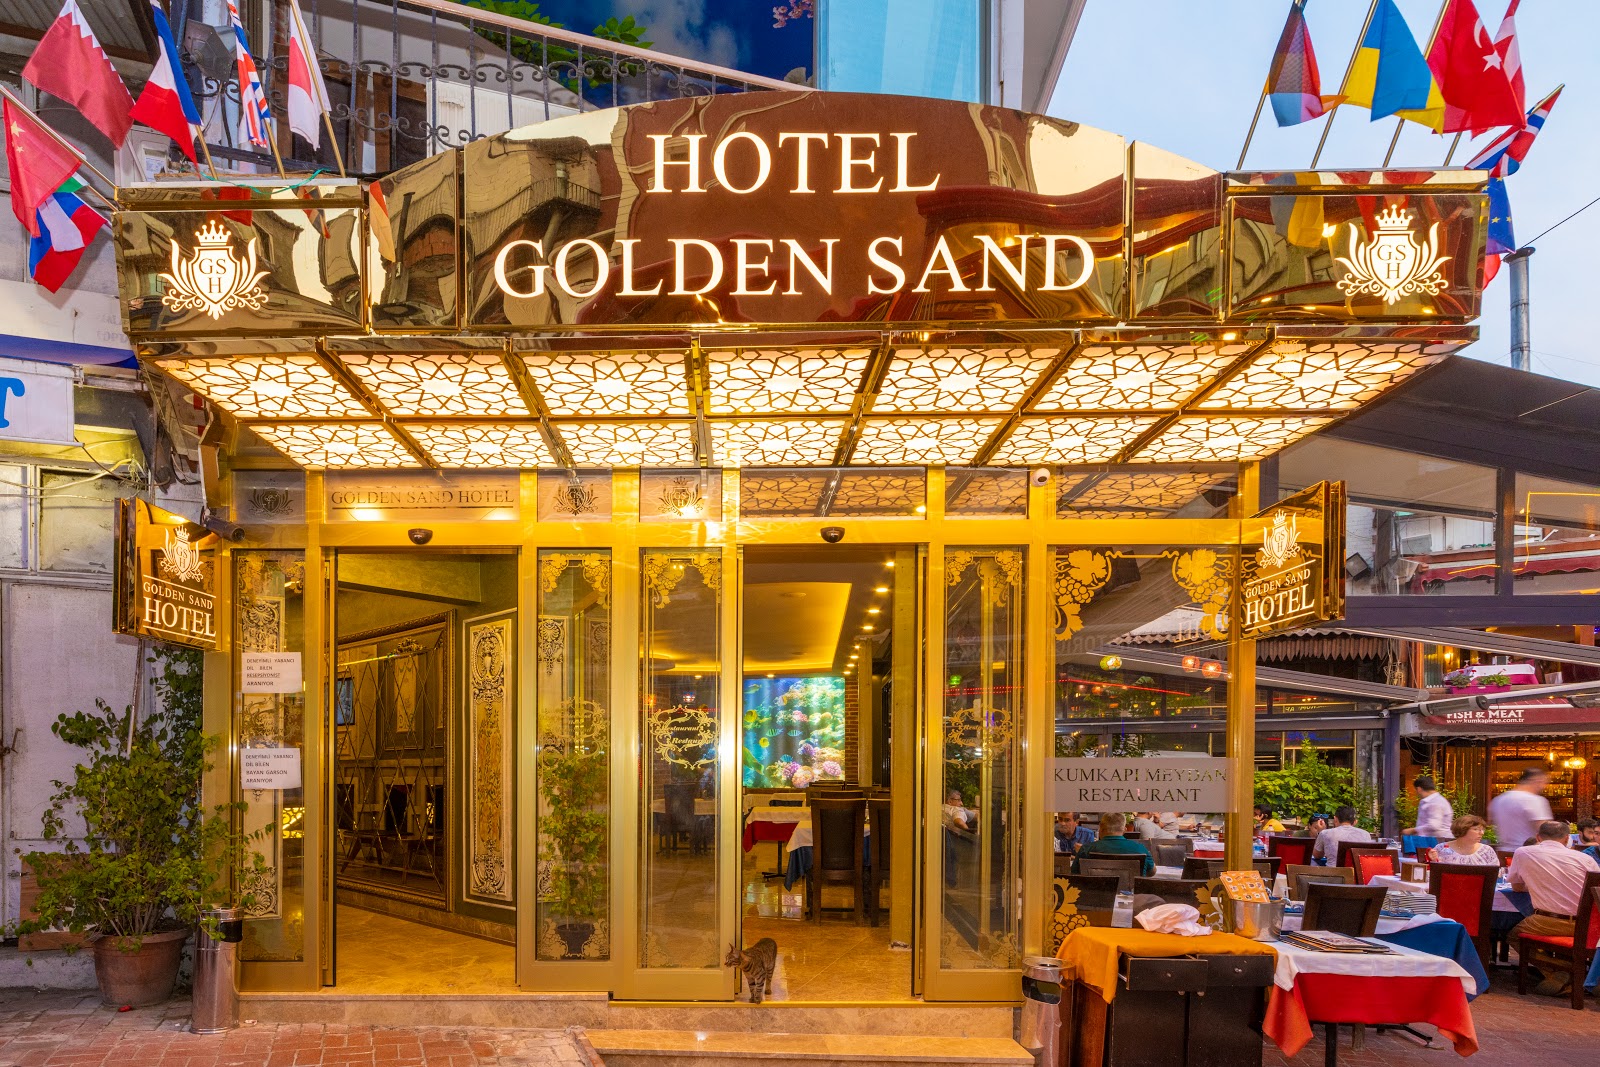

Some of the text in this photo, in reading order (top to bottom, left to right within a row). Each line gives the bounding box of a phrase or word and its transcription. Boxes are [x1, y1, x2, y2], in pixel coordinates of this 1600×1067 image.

[646, 132, 941, 194] HOTEL
[1377, 244, 1407, 261] GS
[198, 258, 227, 275] GS
[493, 234, 1095, 299] GOLDEN SAND
[1386, 262, 1401, 279] H
[208, 277, 222, 294] H
[331, 490, 515, 504] GOLDEN SAND HOTEL
[1245, 568, 1311, 598] GOLDEN SAND
[143, 582, 214, 610] GOLDEN SAND
[1245, 583, 1315, 626] HOTEL
[143, 597, 217, 638] HOTEL
[1475, 711, 1486, 719] &
[1488, 709, 1525, 719] MEAT
[1054, 768, 1227, 782] KUMKAPI MEYDAN
[1079, 788, 1202, 802] RESTAURANT
